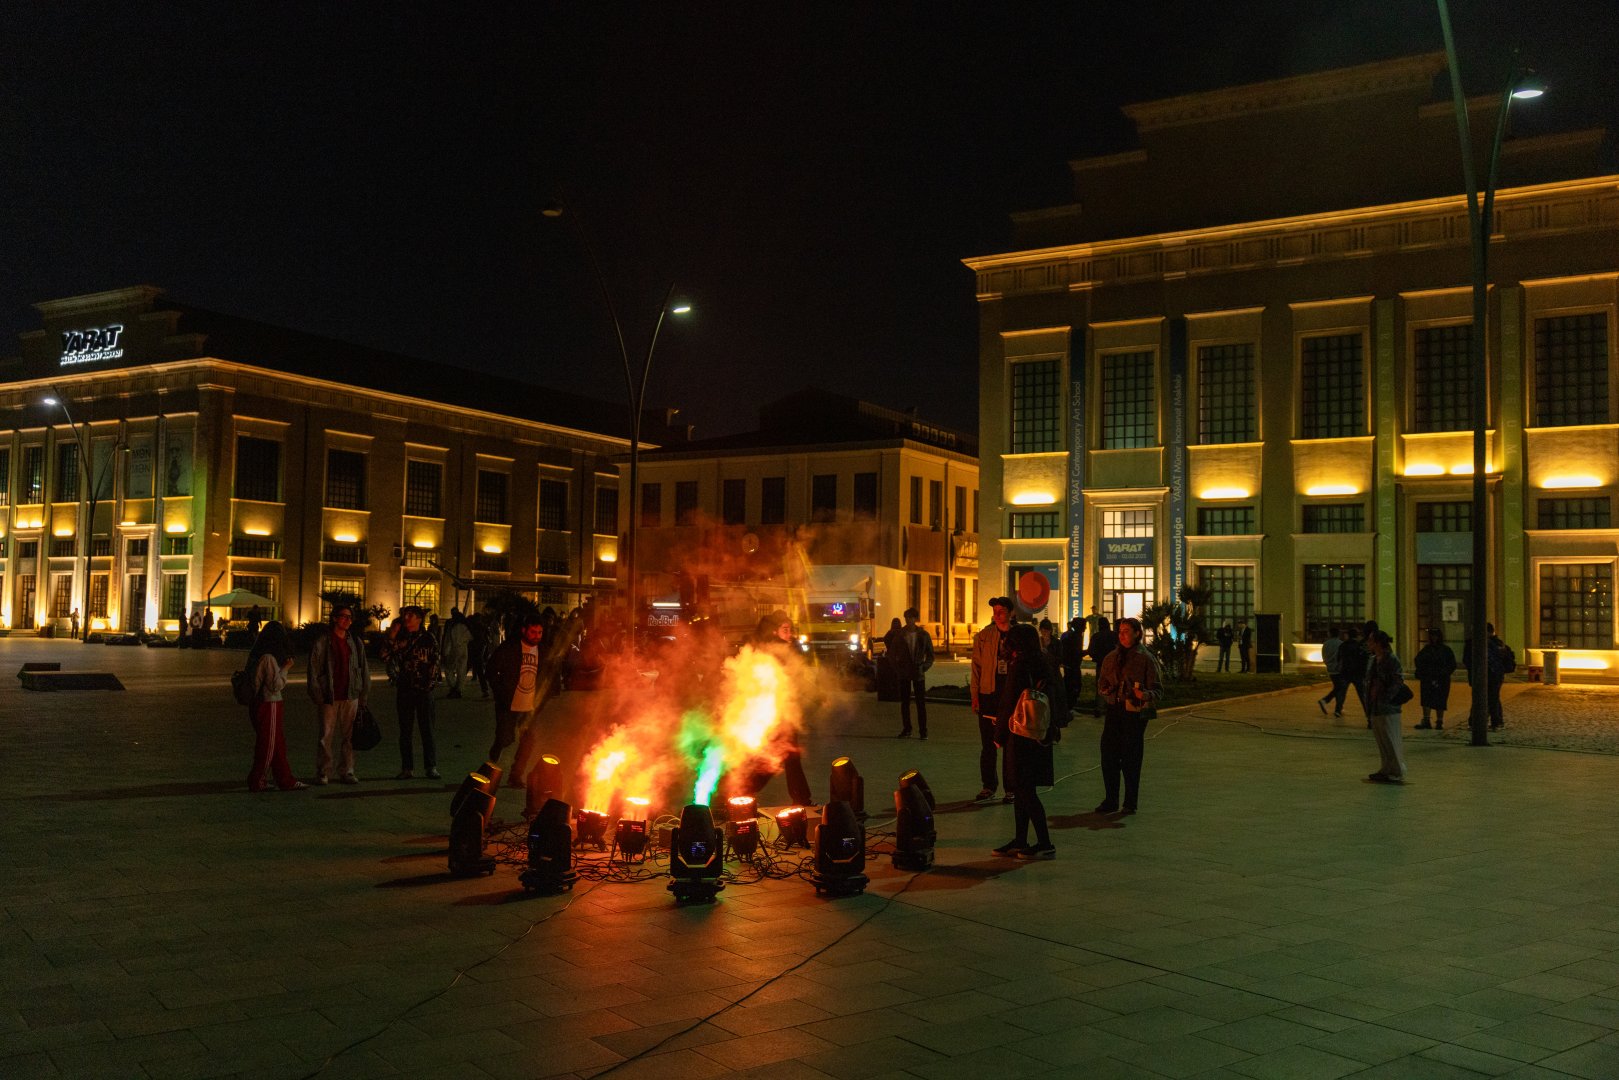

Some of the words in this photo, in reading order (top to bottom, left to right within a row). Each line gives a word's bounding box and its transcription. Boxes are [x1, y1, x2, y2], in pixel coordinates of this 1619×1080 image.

[62, 325, 123, 354] YARAT
[1072, 381, 1081, 407] School
[1072, 408, 1081, 421] Art
[1071, 423, 1082, 477] Contemporary
[1071, 479, 1080, 506] YARAT
[1173, 475, 1182, 503] YARAT
[1071, 525, 1080, 558] Infinite
[1107, 543, 1145, 553] YARAT
[1071, 560, 1080, 570] to
[1071, 572, 1080, 598] Finite
